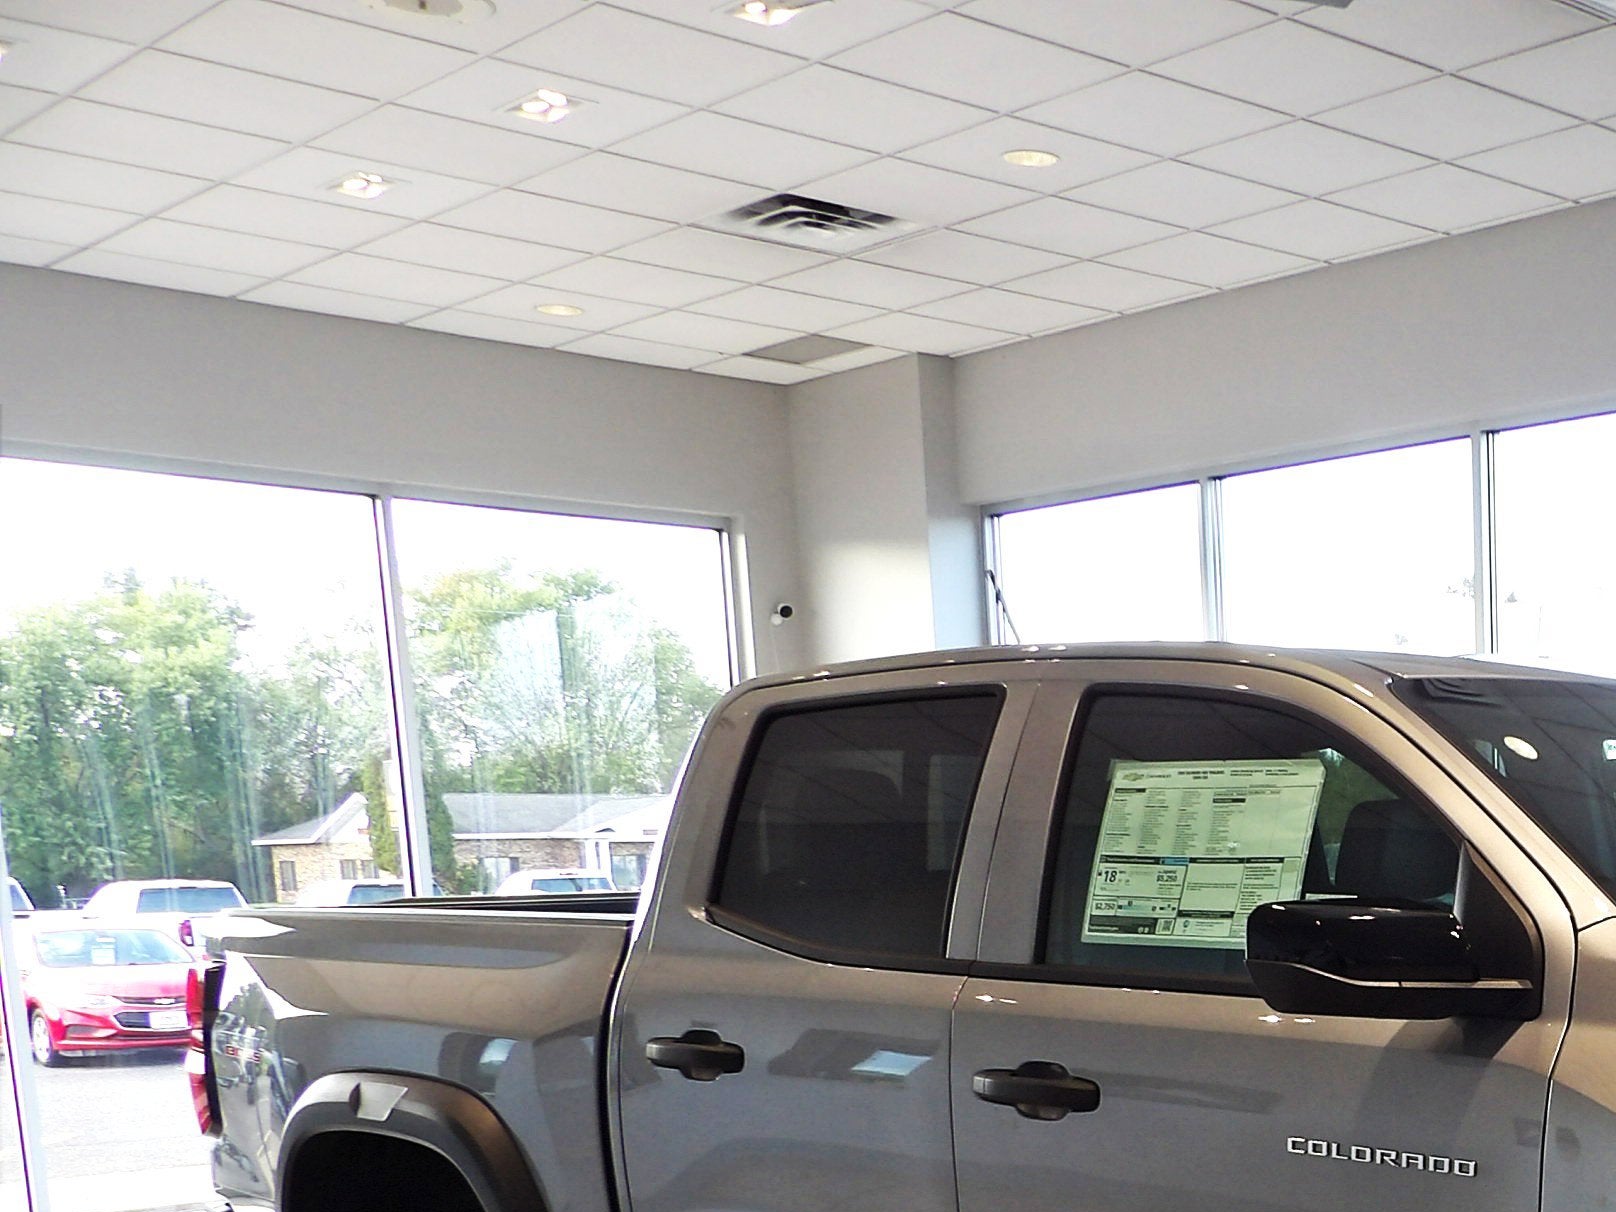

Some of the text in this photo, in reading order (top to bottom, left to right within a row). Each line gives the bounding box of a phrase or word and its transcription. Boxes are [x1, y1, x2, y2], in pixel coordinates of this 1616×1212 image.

[1104, 870, 1117, 883] 18
[1095, 902, 1115, 911] $2,750
[1286, 1136, 1478, 1177] COLORADO
